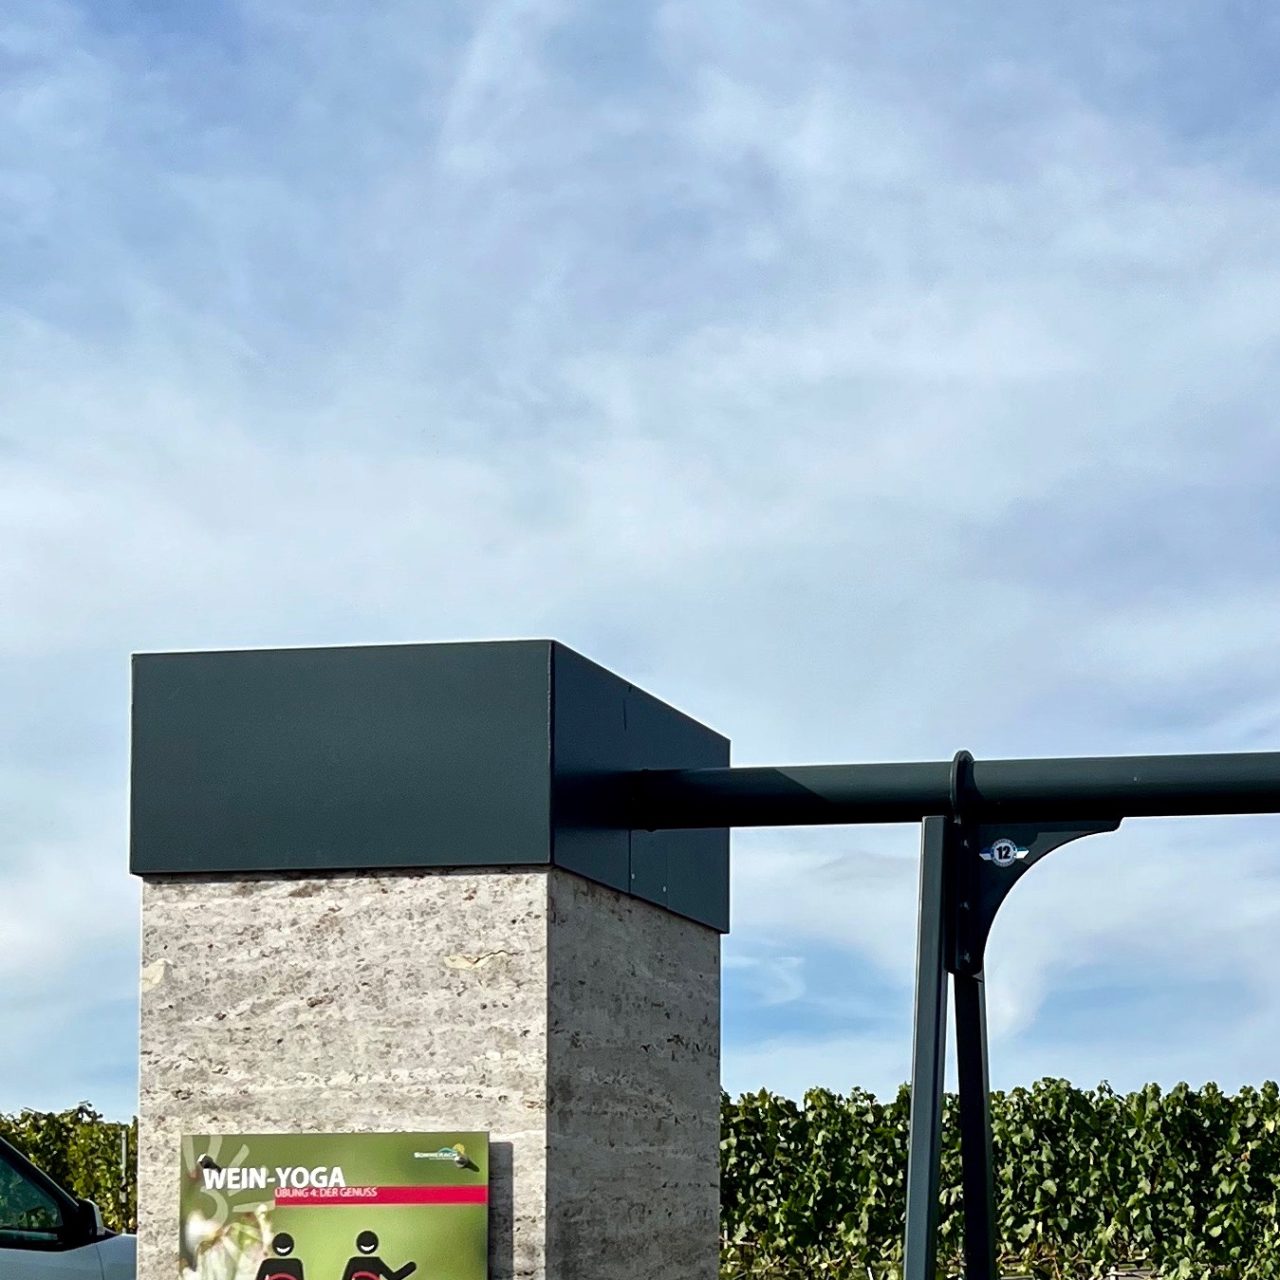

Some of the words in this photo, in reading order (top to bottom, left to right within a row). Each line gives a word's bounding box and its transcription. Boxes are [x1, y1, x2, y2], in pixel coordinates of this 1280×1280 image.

[997, 845, 1011, 860] 12
[202, 1166, 346, 1190] WEIN-YOGA
[275, 1186, 309, 1198] ÜBUNG
[320, 1187, 340, 1198] DER
[340, 1186, 378, 1198] GENUSS
